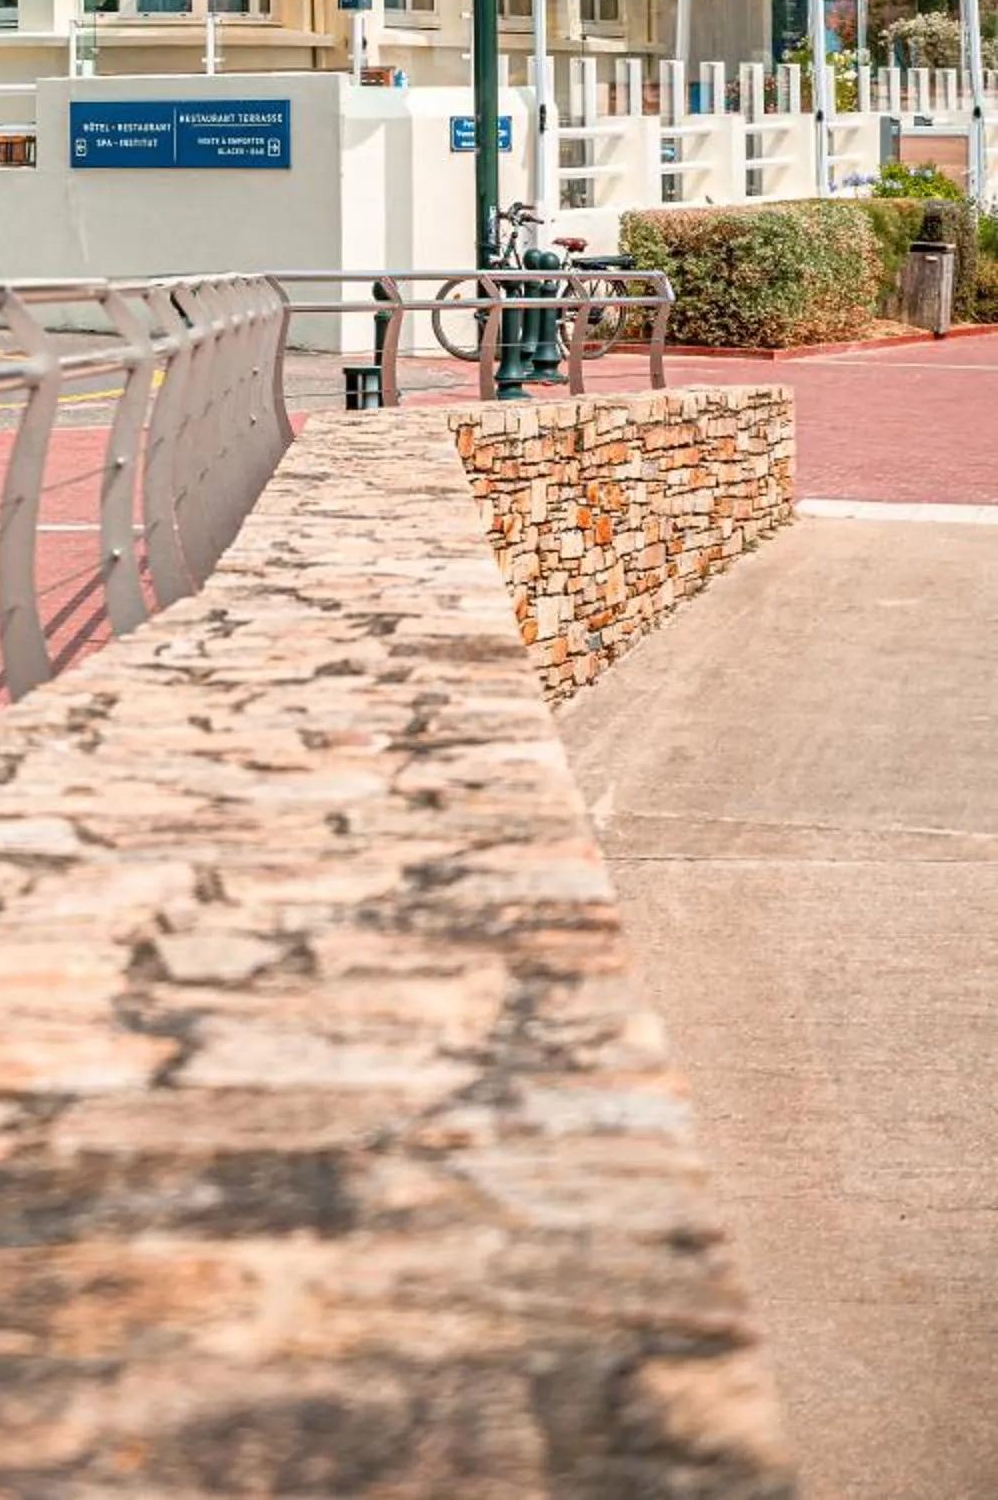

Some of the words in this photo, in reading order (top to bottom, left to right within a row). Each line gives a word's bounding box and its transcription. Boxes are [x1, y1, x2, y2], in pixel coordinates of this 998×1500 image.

[179, 113, 235, 123] RESTAURANT
[238, 112, 283, 123] TERRASSE
[83, 122, 110, 133] HÔTEL
[117, 123, 171, 133] RESTAURANT
[96, 138, 113, 147] SPA
